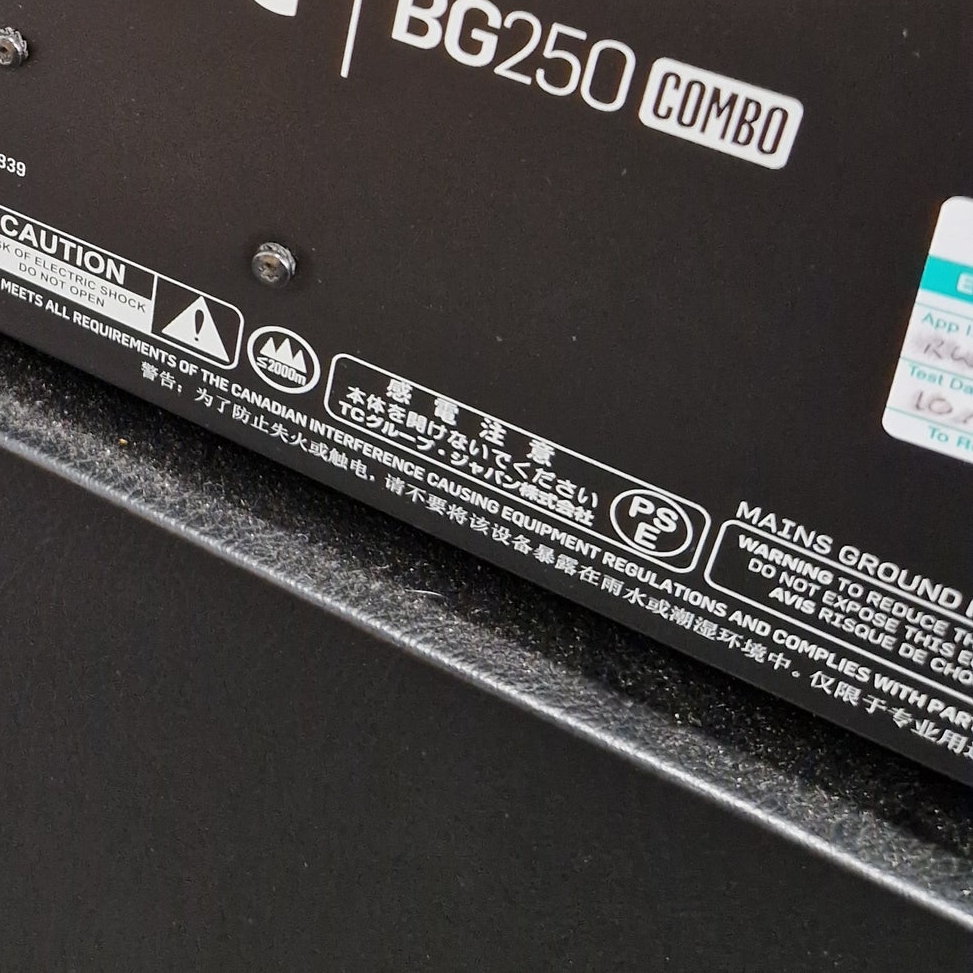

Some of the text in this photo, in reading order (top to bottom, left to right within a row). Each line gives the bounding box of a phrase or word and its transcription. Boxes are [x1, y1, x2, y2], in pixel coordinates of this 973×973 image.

[651, 70, 790, 156] COMBO
[0, 213, 126, 286] CAUTION
[14, 247, 32, 261] OF
[34, 256, 97, 291] ELECTRIC
[100, 285, 147, 314] SHOCK
[18, 262, 106, 308] DO NOT OPEN
[921, 312, 959, 334] App
[909, 363, 943, 385] Test
[929, 425, 949, 443] To
[0, 277, 44, 308] MEETS
[45, 299, 71, 321] ALL
[72, 310, 178, 369] REQUIREMENTS
[179, 358, 199, 377] OF
[200, 368, 230, 393] THE
[230, 383, 308, 429] CANADIAN
[309, 418, 425, 481] INTERFERENCE
[426, 472, 500, 514] CAUSING
[501, 505, 602, 560] EQUIPMENT
[602, 551, 729, 618] REGULATIONS
[728, 609, 773, 638] AND
[772, 628, 873, 683] COMPLIES
[874, 672, 929, 709] WITH
[927, 698, 973, 731] PAR
[735, 500, 964, 610] MAINS GROUND
[737, 533, 835, 586] WARNING
[837, 576, 865, 599] TO
[865, 590, 952, 637] REDUCE
[747, 556, 777, 579] DO
[779, 570, 822, 597] NOT
[821, 590, 901, 635] EXPOSE
[903, 624, 958, 659] THIS
[768, 586, 817, 615] AVIS
[817, 606, 899, 652] RISQUE
[898, 641, 929, 666] DE
